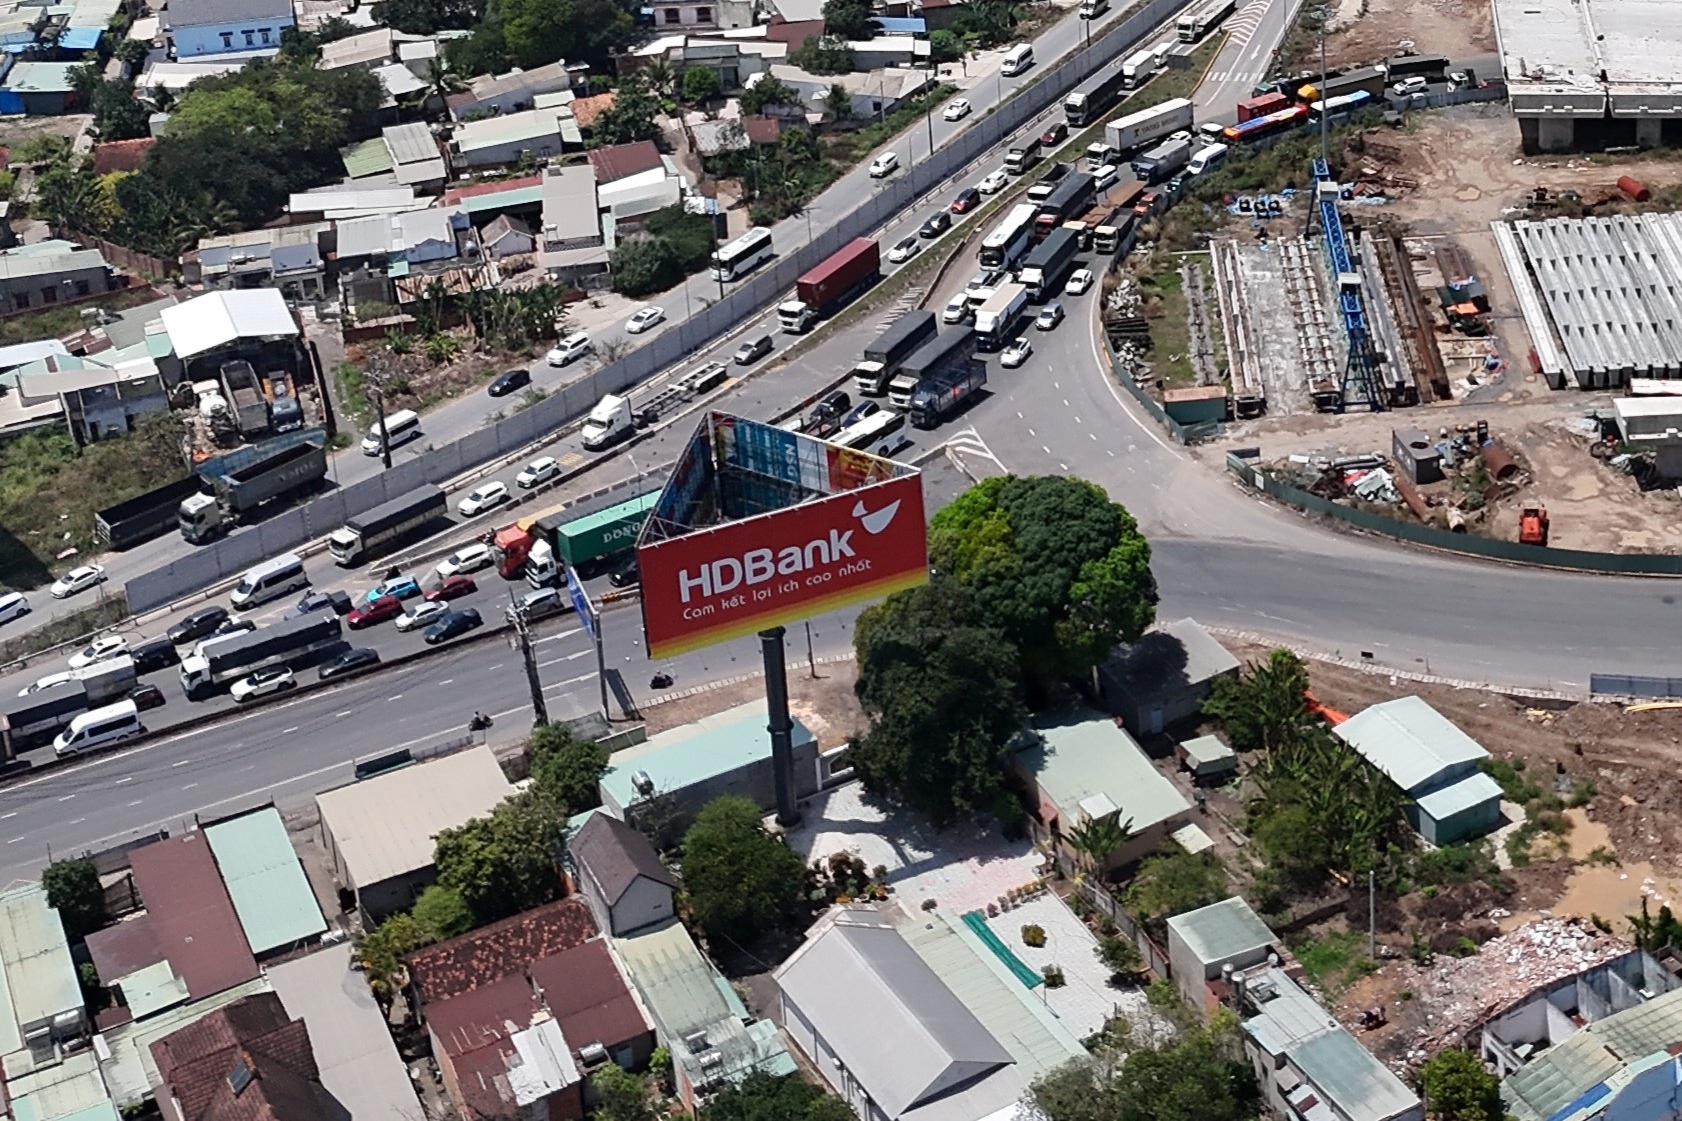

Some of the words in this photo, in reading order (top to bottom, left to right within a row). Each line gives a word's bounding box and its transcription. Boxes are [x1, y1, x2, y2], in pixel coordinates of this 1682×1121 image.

[678, 528, 856, 603] HDBank
[683, 604, 715, 620] Cam
[721, 594, 747, 610] kết
[752, 587, 771, 601] lợi
[778, 579, 799, 594] ích
[805, 571, 832, 586] cao
[839, 558, 871, 577] nhất
